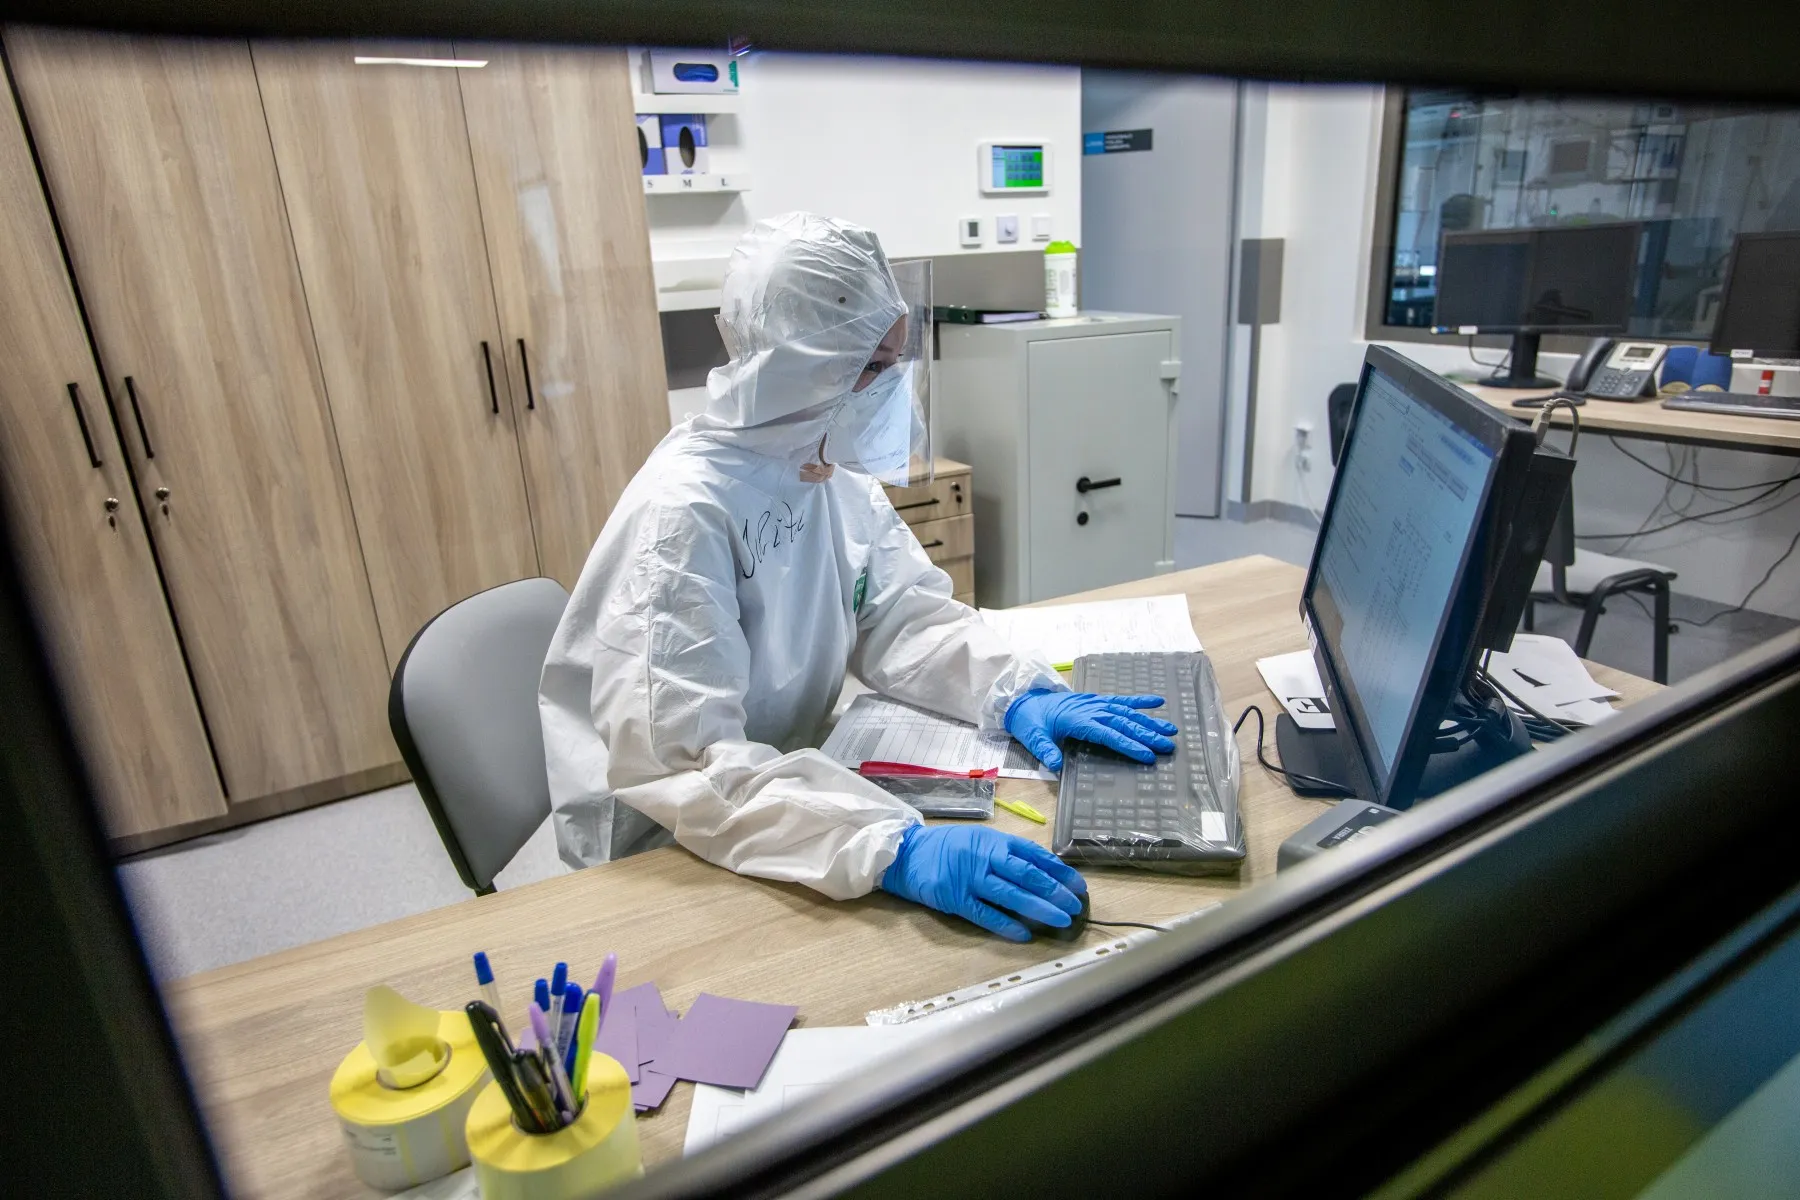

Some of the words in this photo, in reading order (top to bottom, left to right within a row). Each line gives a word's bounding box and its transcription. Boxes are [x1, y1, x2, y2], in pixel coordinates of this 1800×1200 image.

[683, 179, 692, 188] M
[1286, 697, 1332, 714] E
[1332, 826, 1353, 840] ZEBRA
